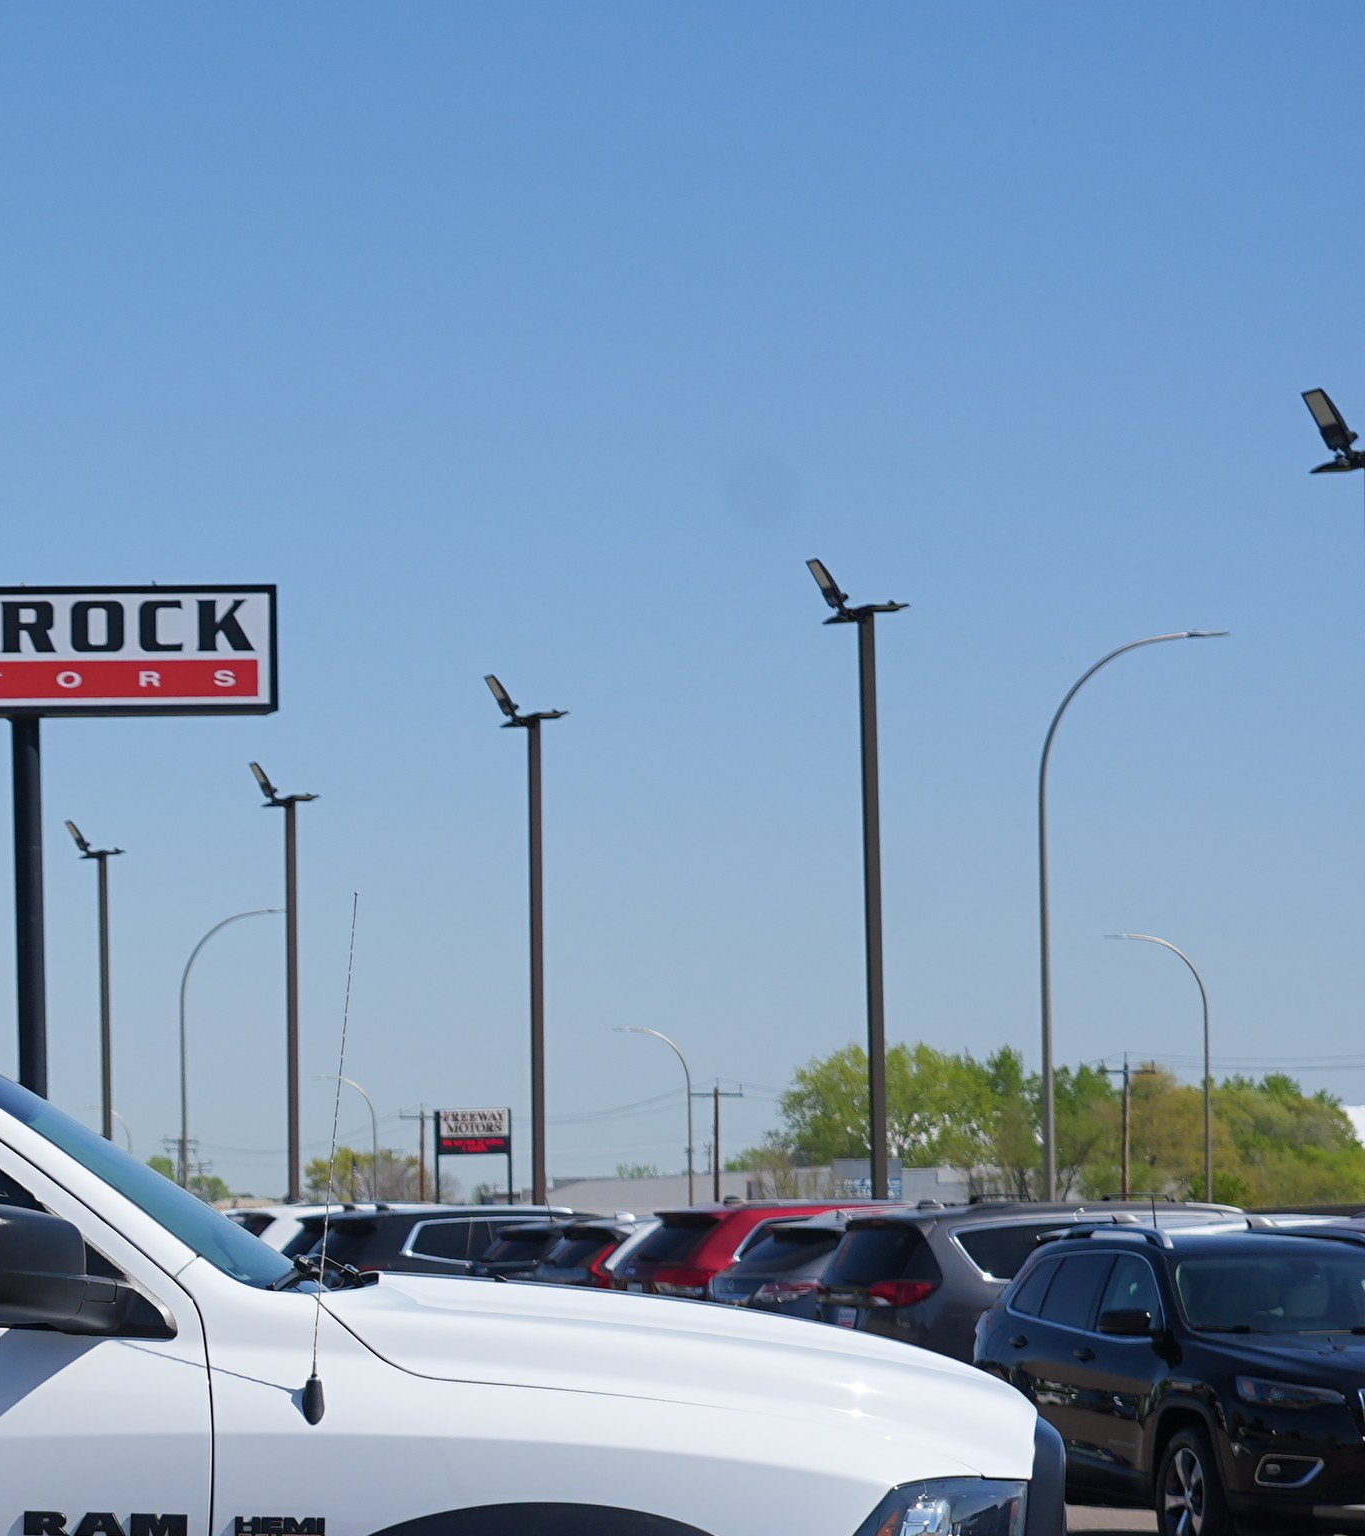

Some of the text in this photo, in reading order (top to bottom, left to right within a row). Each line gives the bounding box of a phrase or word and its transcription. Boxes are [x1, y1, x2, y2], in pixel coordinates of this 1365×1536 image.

[442, 1110, 504, 1121] FREEWAY
[446, 1121, 502, 1133] MOTORS
[235, 1516, 325, 1533] HEMI
